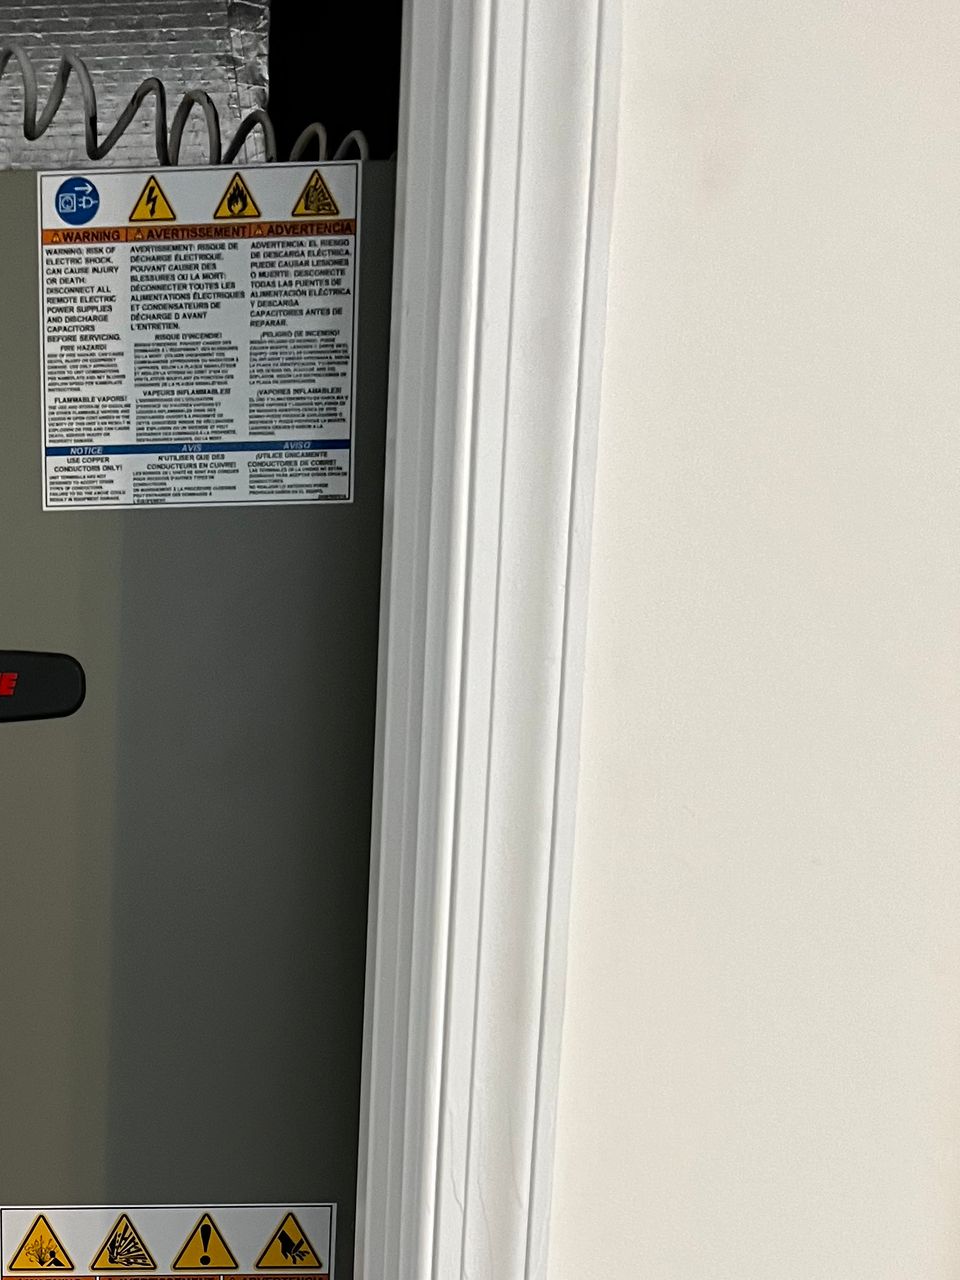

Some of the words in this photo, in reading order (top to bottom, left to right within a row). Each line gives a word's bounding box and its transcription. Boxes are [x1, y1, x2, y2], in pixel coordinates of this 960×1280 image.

[147, 226, 247, 240] AVERTISSEMENT
[267, 222, 353, 236] ADVERTENCIA
[62, 230, 121, 243] WARNING
[251, 251, 260, 259] DE
[263, 250, 304, 258] DESCARGA
[278, 260, 309, 268] CAUSAR
[311, 259, 349, 267] LESIONES
[131, 274, 174, 282] BLESSURES
[189, 282, 218, 290] TOUTES
[221, 281, 235, 289] LES
[131, 292, 190, 301] ALIMENTATIONS
[142, 302, 208, 310] CONDENSATEURS
[250, 309, 303, 317] CAPACITORES
[64, 315, 108, 323] DISCHARGE
[143, 389, 174, 397] VAPEURS
[181, 443, 202, 452] AVIS
[283, 441, 311, 450] AVISO
[70, 446, 103, 455] NOTICE
